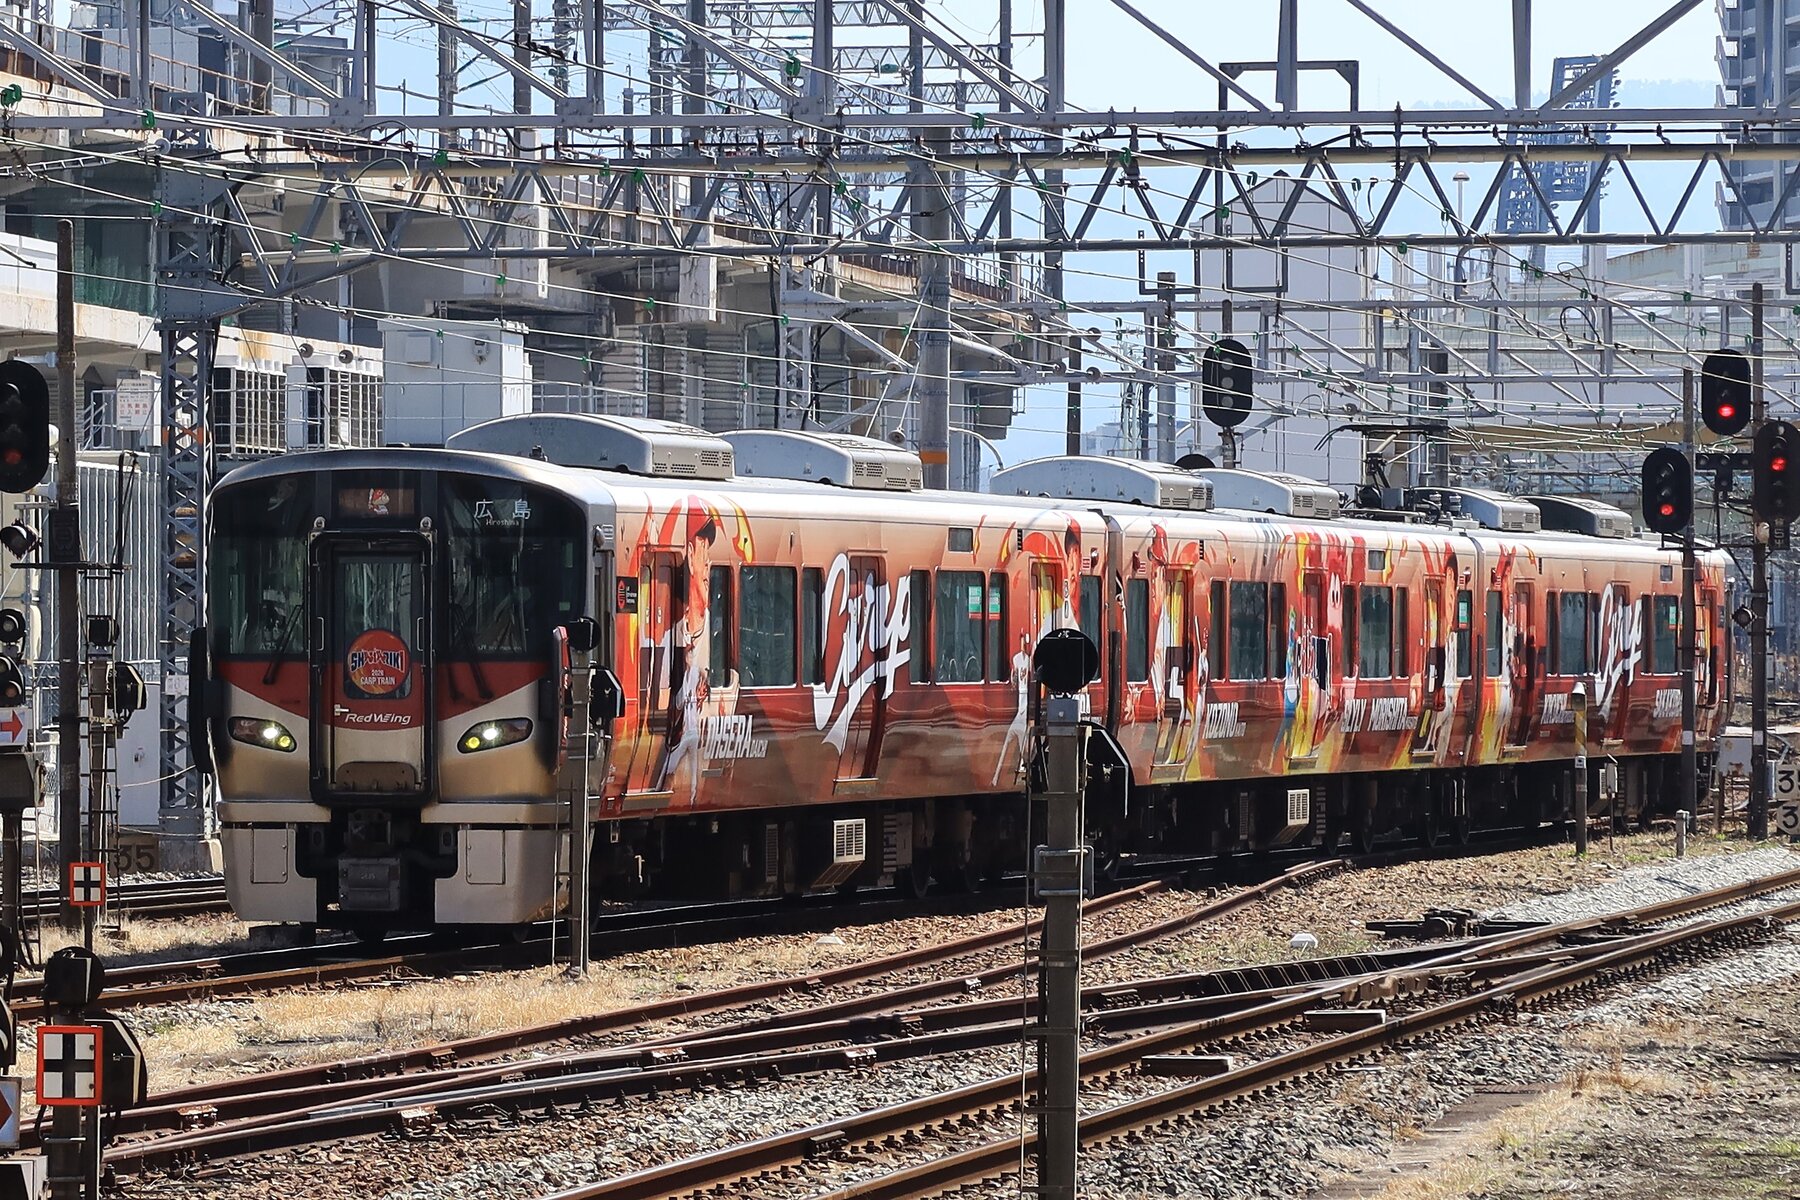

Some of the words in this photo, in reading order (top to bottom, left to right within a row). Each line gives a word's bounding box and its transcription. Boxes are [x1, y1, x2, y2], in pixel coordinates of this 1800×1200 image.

[474, 498, 532, 519] 広島
[360, 676, 377, 686] CARP
[377, 676, 396, 686] TRAIN
[1202, 702, 1239, 739] KOZONO
[703, 714, 753, 760] OHSERA
[1778, 769, 1800, 794] 3
